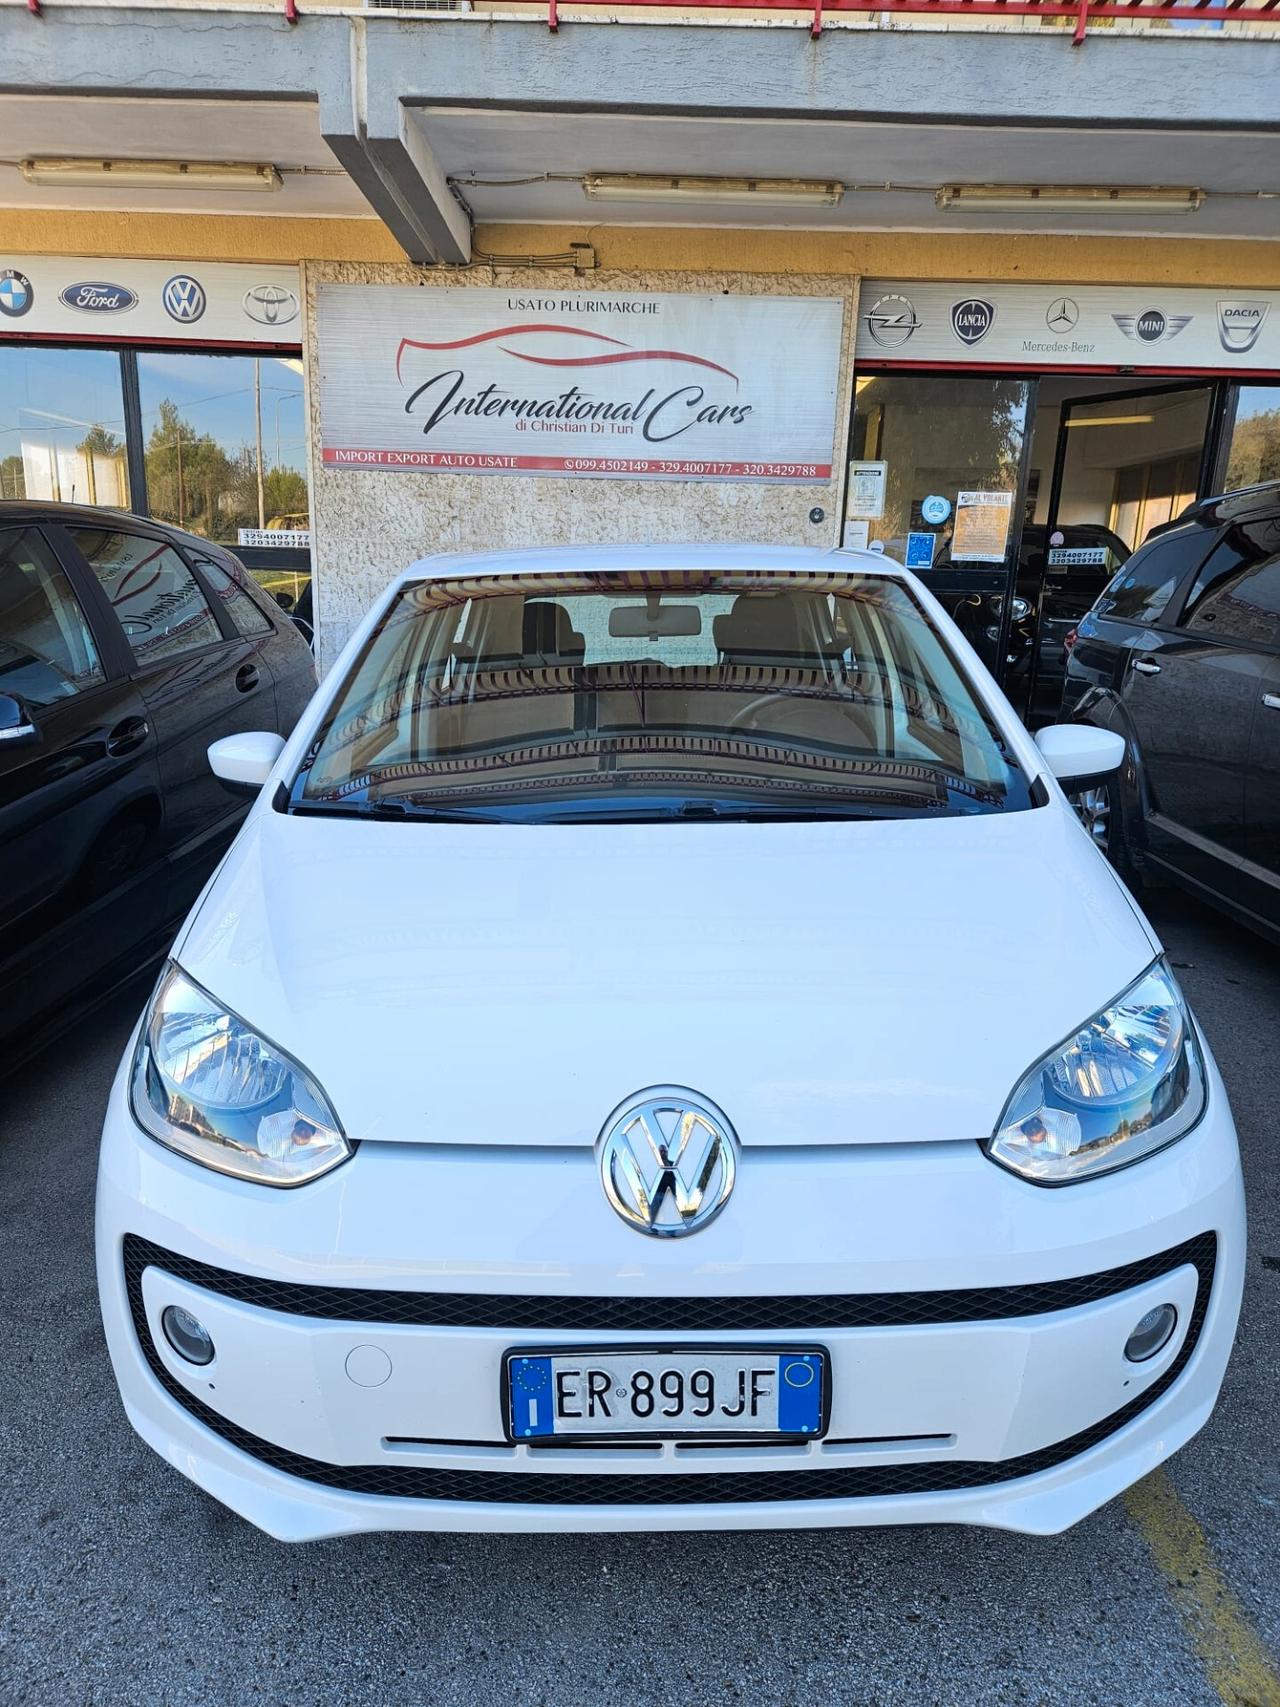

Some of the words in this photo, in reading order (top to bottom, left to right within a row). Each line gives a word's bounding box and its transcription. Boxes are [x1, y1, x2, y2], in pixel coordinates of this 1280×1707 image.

[76, 285, 120, 307] Ford
[508, 298, 556, 312] USATO
[560, 299, 661, 314] PLURIMARCHE
[1224, 308, 1260, 318] DACIA
[958, 314, 986, 327] LANCIA
[1138, 320, 1164, 332] MINI
[1022, 340, 1096, 353] Mercedes-Benz
[404, 370, 656, 434] International
[642, 385, 754, 442] Cars
[515, 419, 527, 431] di
[531, 420, 587, 433] Christian
[591, 422, 605, 434] Di
[609, 422, 634, 435] Turi
[335, 450, 384, 463] IMPORT
[387, 452, 436, 465] EXPORT
[439, 454, 475, 467] AUTO
[478, 456, 518, 468] USATE
[575, 459, 649, 472] 099.4502149
[659, 462, 732, 475] 329.4007177
[742, 464, 816, 477] 320.3429788
[244, 533, 310, 541] 3294007177
